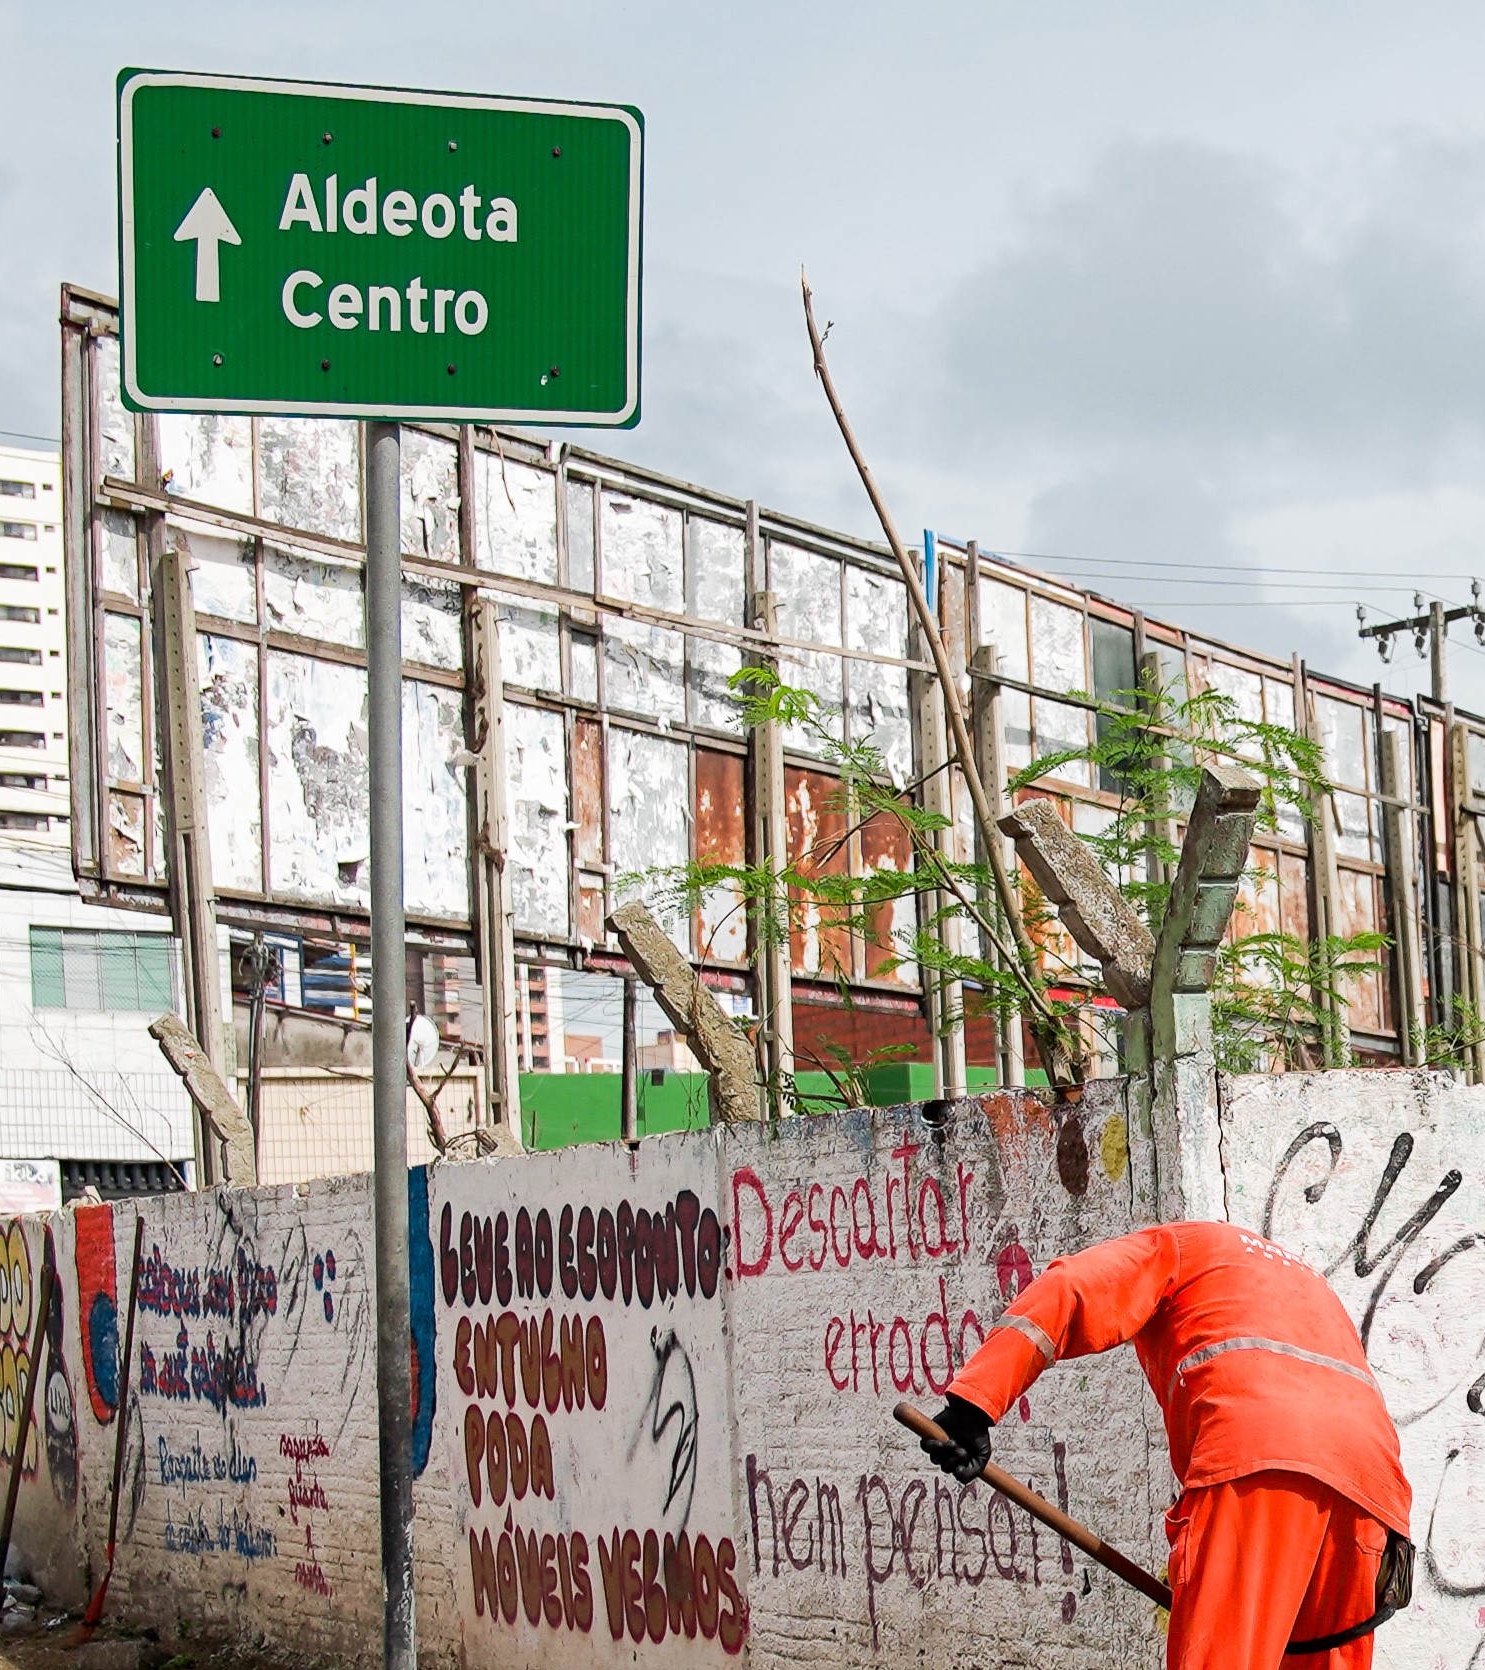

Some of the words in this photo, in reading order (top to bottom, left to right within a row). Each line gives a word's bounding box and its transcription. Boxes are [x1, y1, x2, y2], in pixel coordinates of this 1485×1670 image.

[278, 173, 518, 242] Aldeota
[282, 269, 489, 335] Centro
[440, 1201, 513, 1307] LEVE
[515, 1206, 554, 1300] AO
[732, 1132, 975, 1281] Descartar
[453, 1307, 608, 1415] ENTULHO
[464, 1404, 555, 1508] PODA
[746, 1453, 847, 1578] nem
[598, 1526, 746, 1655] VELHOS
